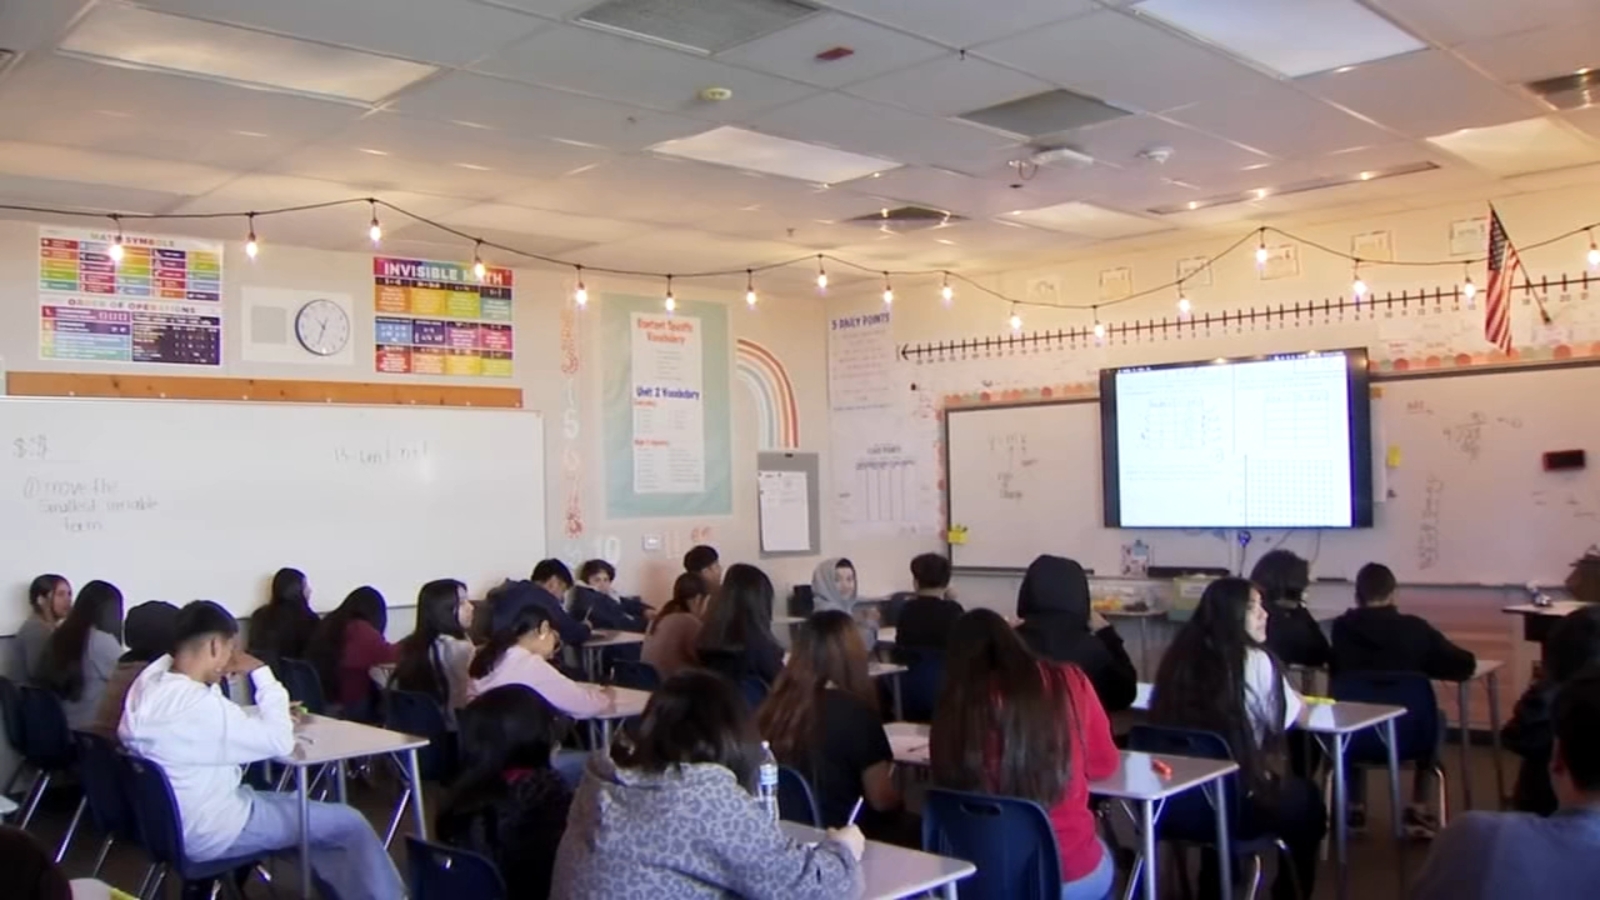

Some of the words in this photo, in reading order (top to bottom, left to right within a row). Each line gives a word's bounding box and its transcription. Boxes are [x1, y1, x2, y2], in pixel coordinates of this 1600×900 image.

[384, 261, 458, 281] INVISIBLE
[839, 316, 861, 330] DAILY
[862, 311, 890, 326] POINTS
[636, 385, 654, 398] Unit
[662, 387, 700, 401] Vocabulary
